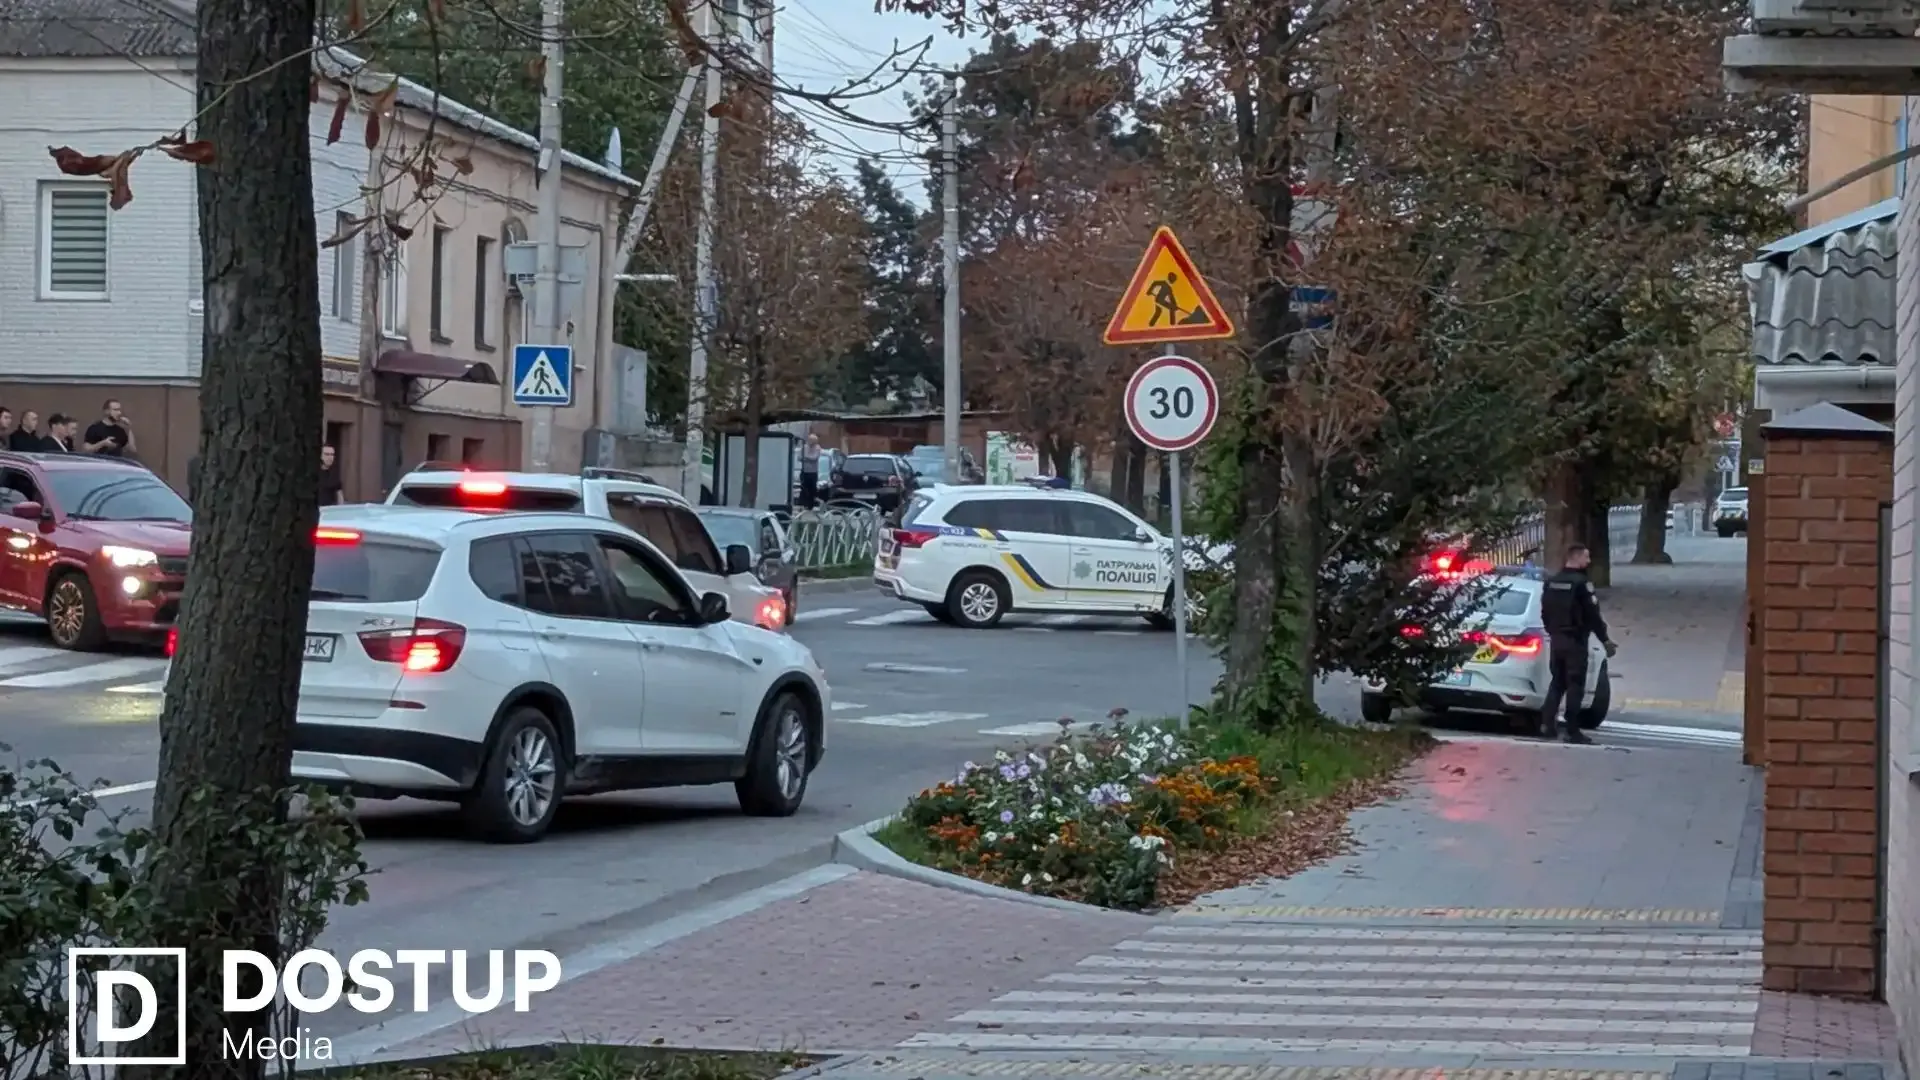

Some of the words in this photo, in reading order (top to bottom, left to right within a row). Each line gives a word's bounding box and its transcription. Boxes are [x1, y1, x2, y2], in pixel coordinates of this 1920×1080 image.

[1149, 386, 1194, 419] 30
[1096, 560, 1157, 570] ПАТРУЛЬНА
[1096, 570, 1157, 584] ПОЛІЦІЯ
